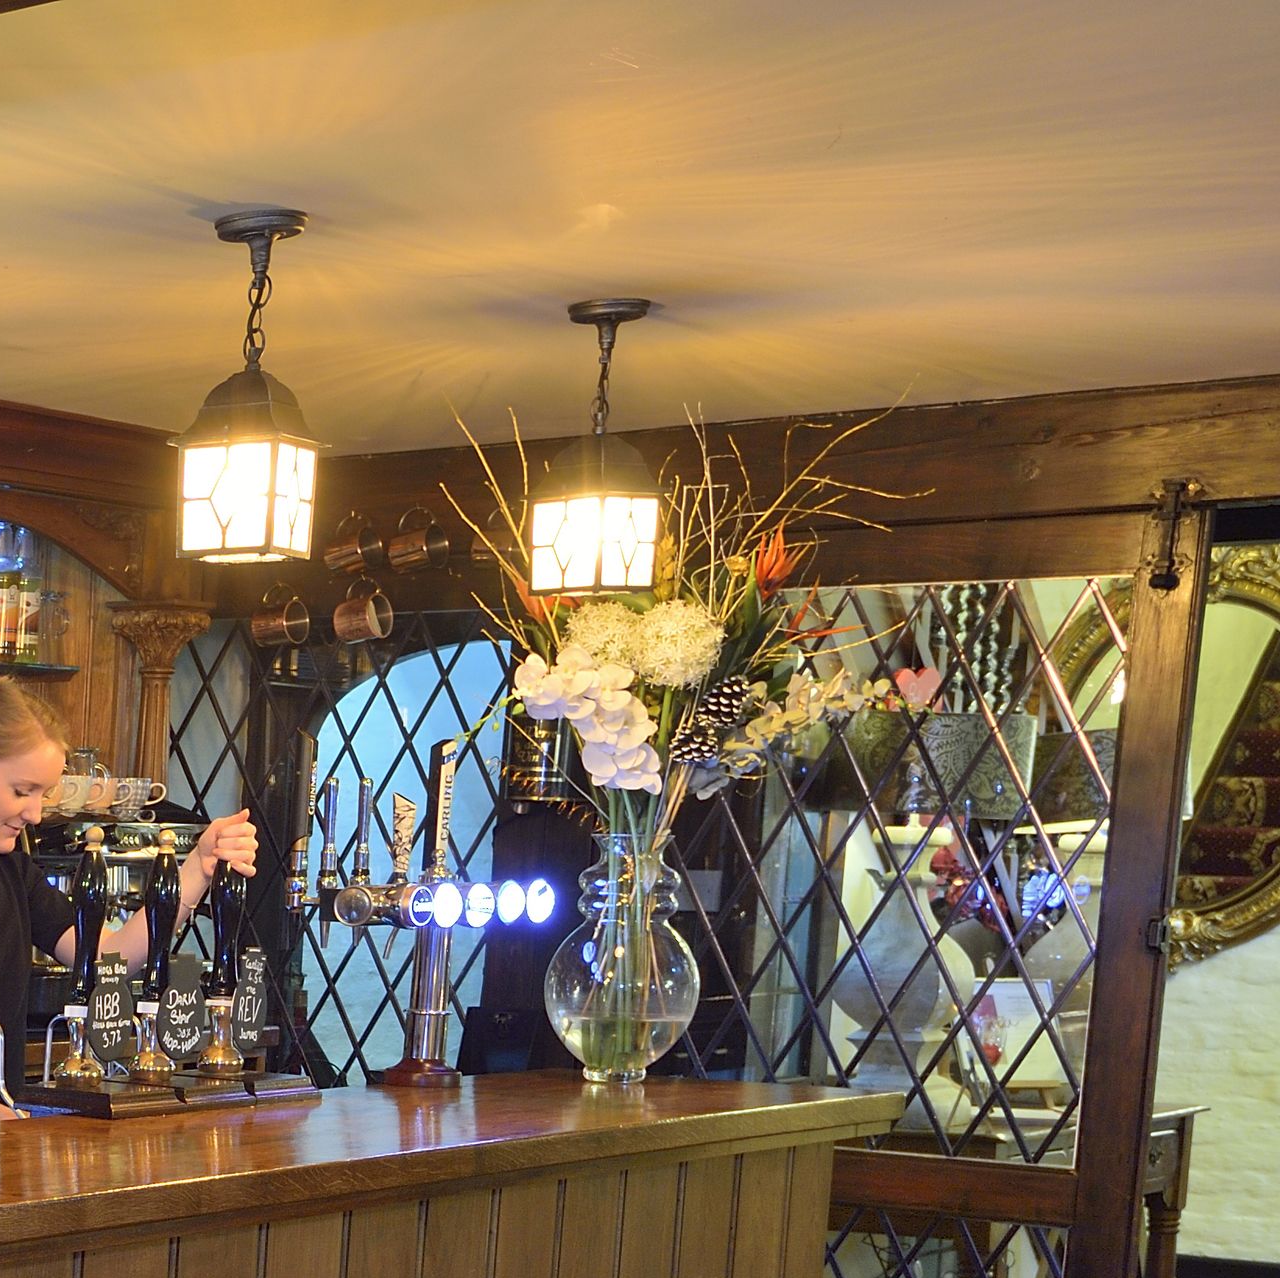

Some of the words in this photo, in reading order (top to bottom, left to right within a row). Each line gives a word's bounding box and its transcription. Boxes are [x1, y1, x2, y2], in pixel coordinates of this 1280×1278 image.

[441, 774, 455, 842] CARLING
[95, 991, 121, 1020] HBB
[237, 996, 262, 1024] REV
